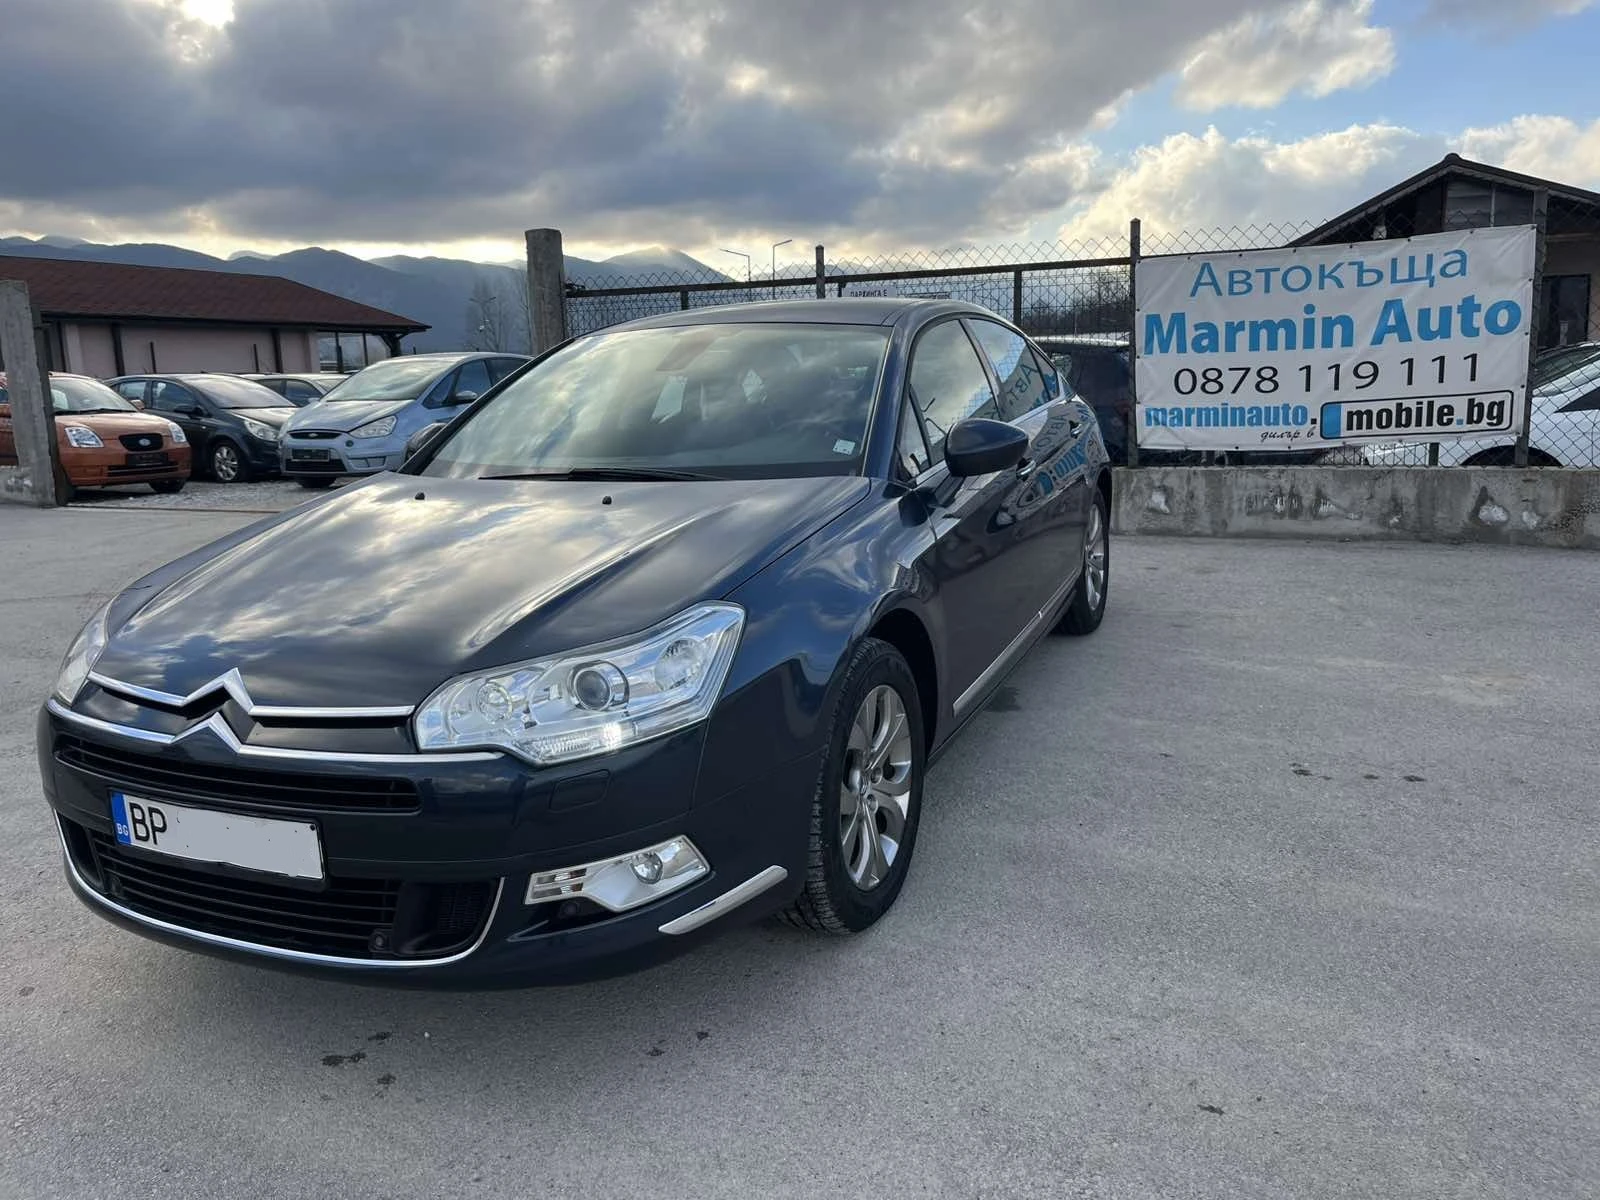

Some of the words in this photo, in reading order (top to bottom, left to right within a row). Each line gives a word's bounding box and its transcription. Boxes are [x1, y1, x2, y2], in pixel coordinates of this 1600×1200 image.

[1190, 249, 1468, 298] Автокъща
[1143, 303, 1355, 356] Marmin
[1370, 294, 1522, 346] Auto
[1173, 365, 1280, 396] 0878
[1298, 360, 1380, 393] 119
[1400, 353, 1478, 387] 111
[1345, 398, 1505, 432] mobile.bg
[116, 822, 129, 837] BG
[129, 802, 167, 845] BP
